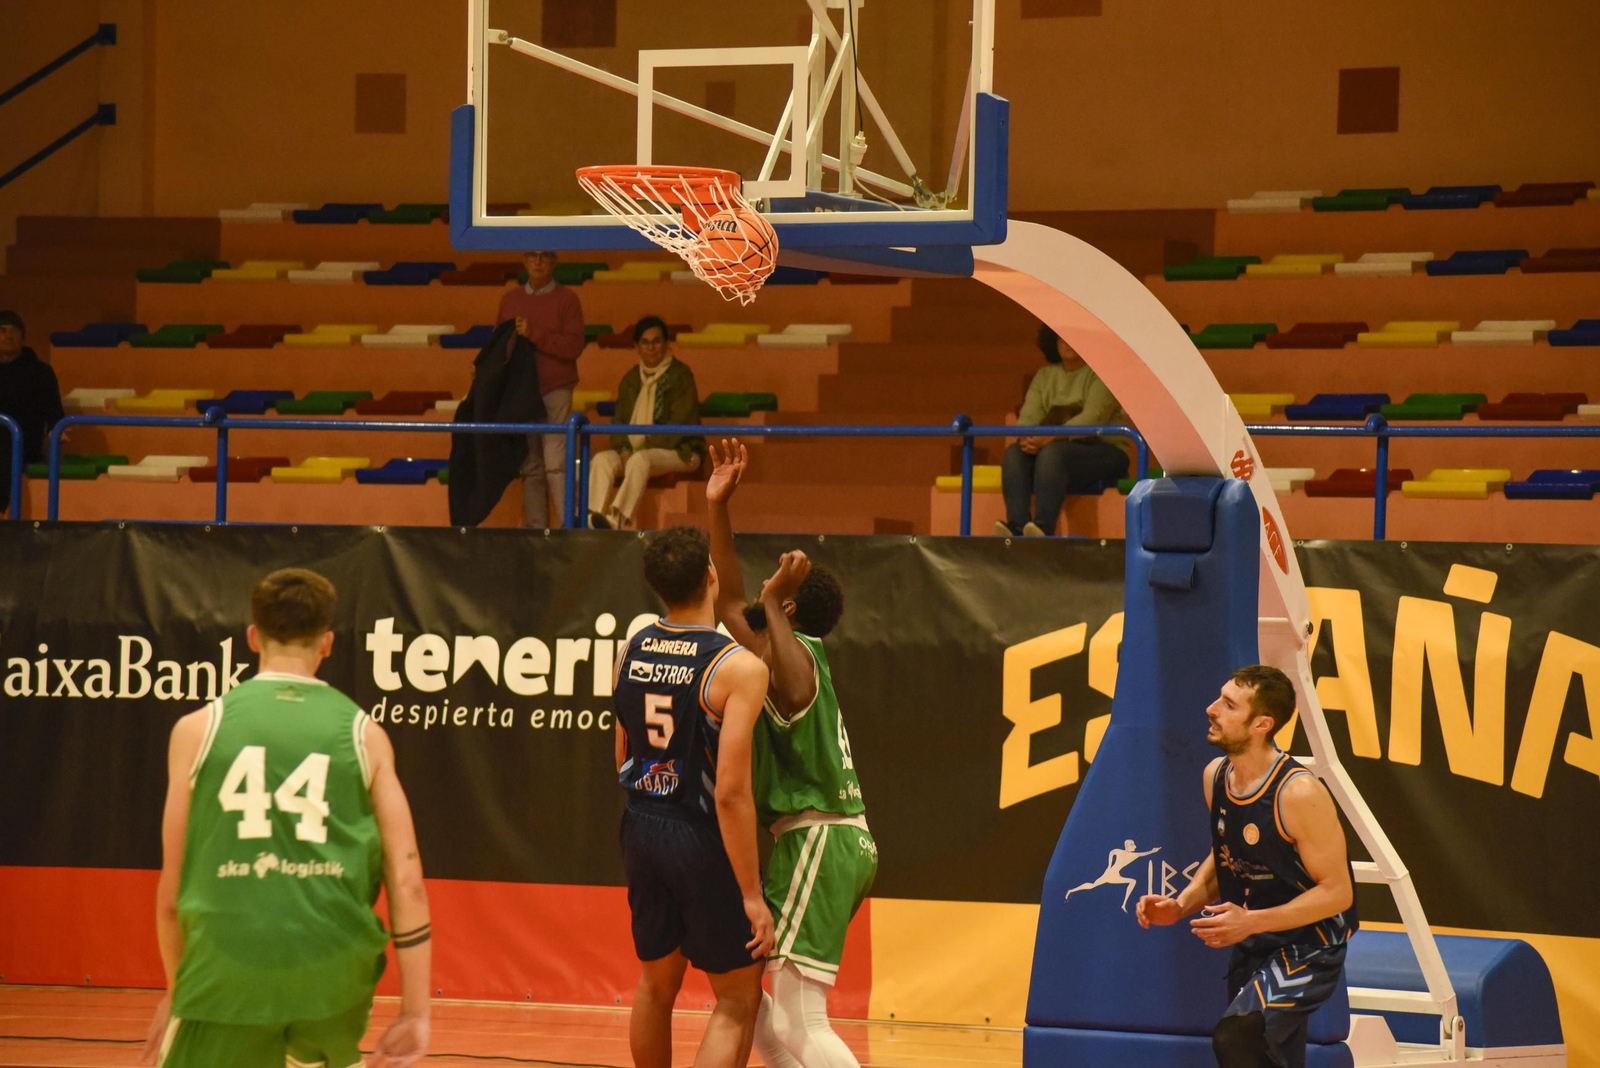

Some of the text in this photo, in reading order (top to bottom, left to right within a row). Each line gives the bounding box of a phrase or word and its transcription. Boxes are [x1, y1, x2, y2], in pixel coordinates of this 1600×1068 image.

[0, 635, 250, 700] aixaBank
[366, 612, 738, 697] teneri
[641, 637, 698, 657] CABRERA
[370, 696, 514, 730] despierta
[999, 563, 1600, 808] EAÑA
[645, 692, 675, 749] 5
[217, 745, 331, 844] 44
[217, 859, 250, 878] ska
